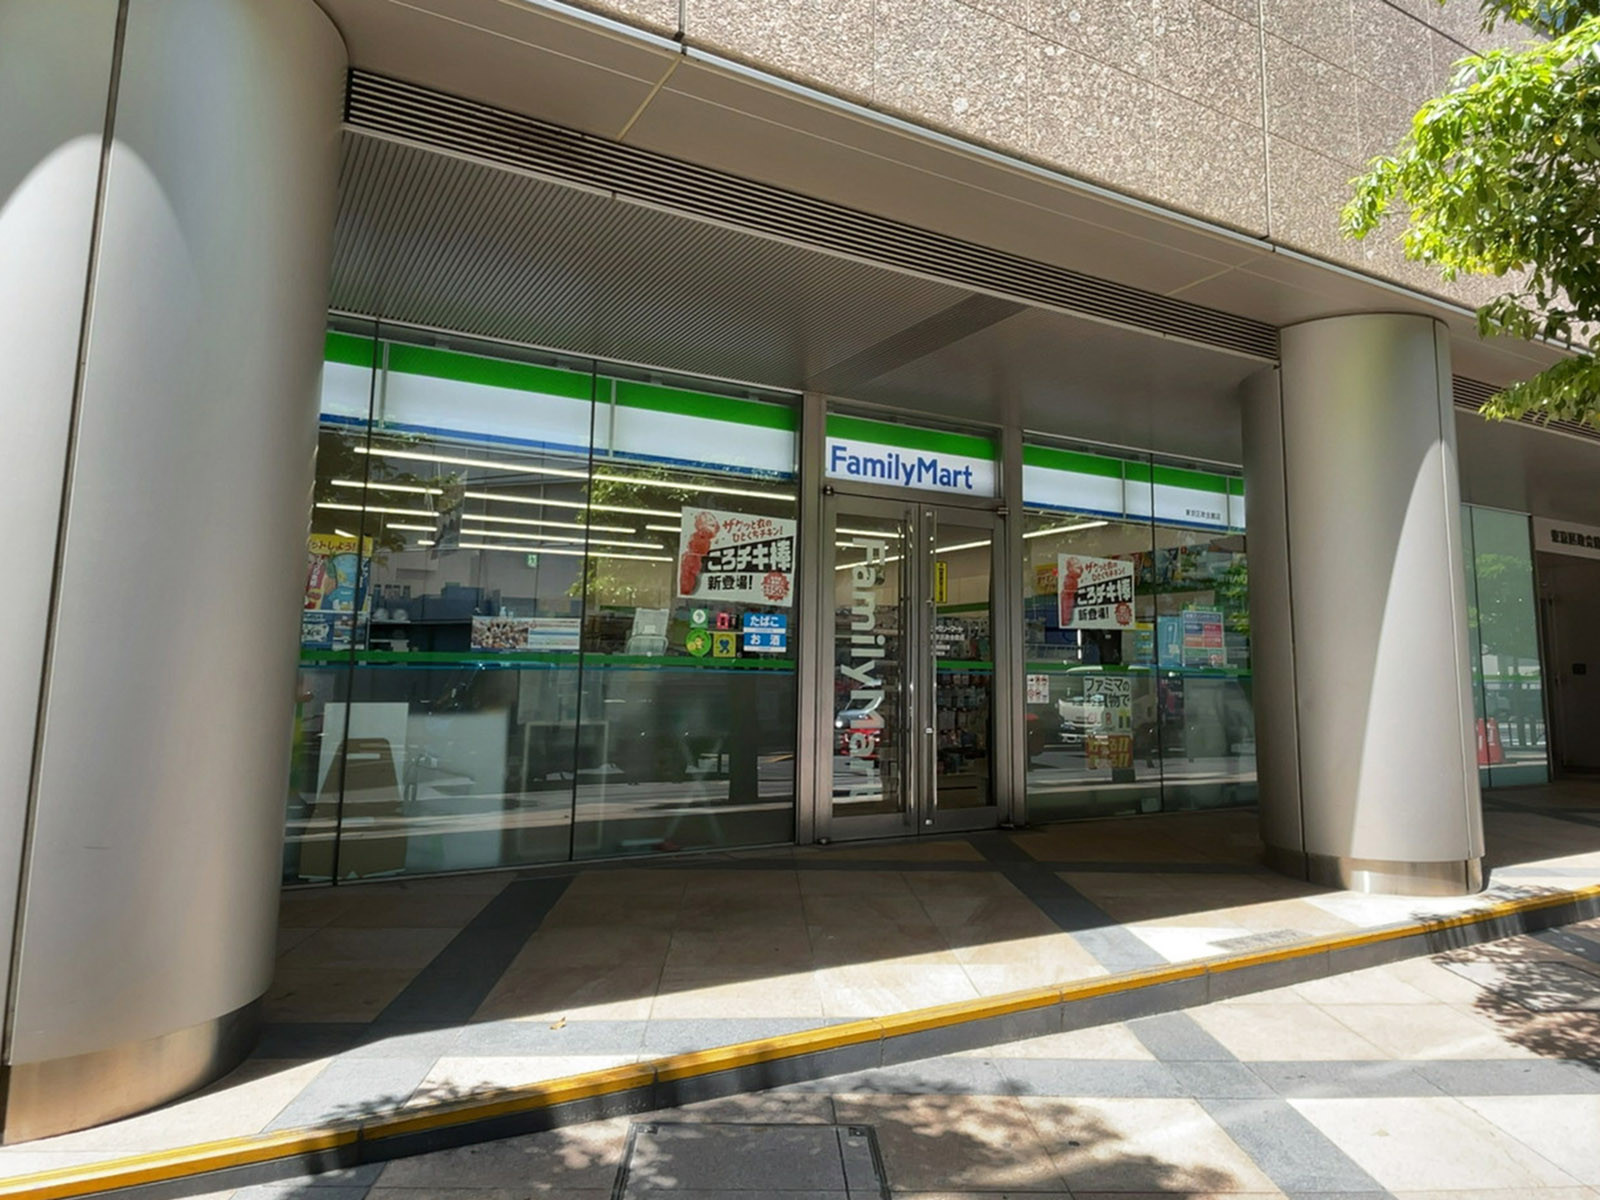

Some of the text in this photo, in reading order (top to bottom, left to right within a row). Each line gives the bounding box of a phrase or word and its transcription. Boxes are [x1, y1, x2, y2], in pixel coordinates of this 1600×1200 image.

[831, 445, 973, 490] FamilyMart
[706, 539, 792, 571] ころチキ棒
[707, 574, 753, 591] 新登場!
[1077, 578, 1131, 605] ころチキ棒
[749, 615, 780, 628] たばこ
[1078, 606, 1110, 621] 新登場!
[1085, 677, 1130, 692] ファミマの
